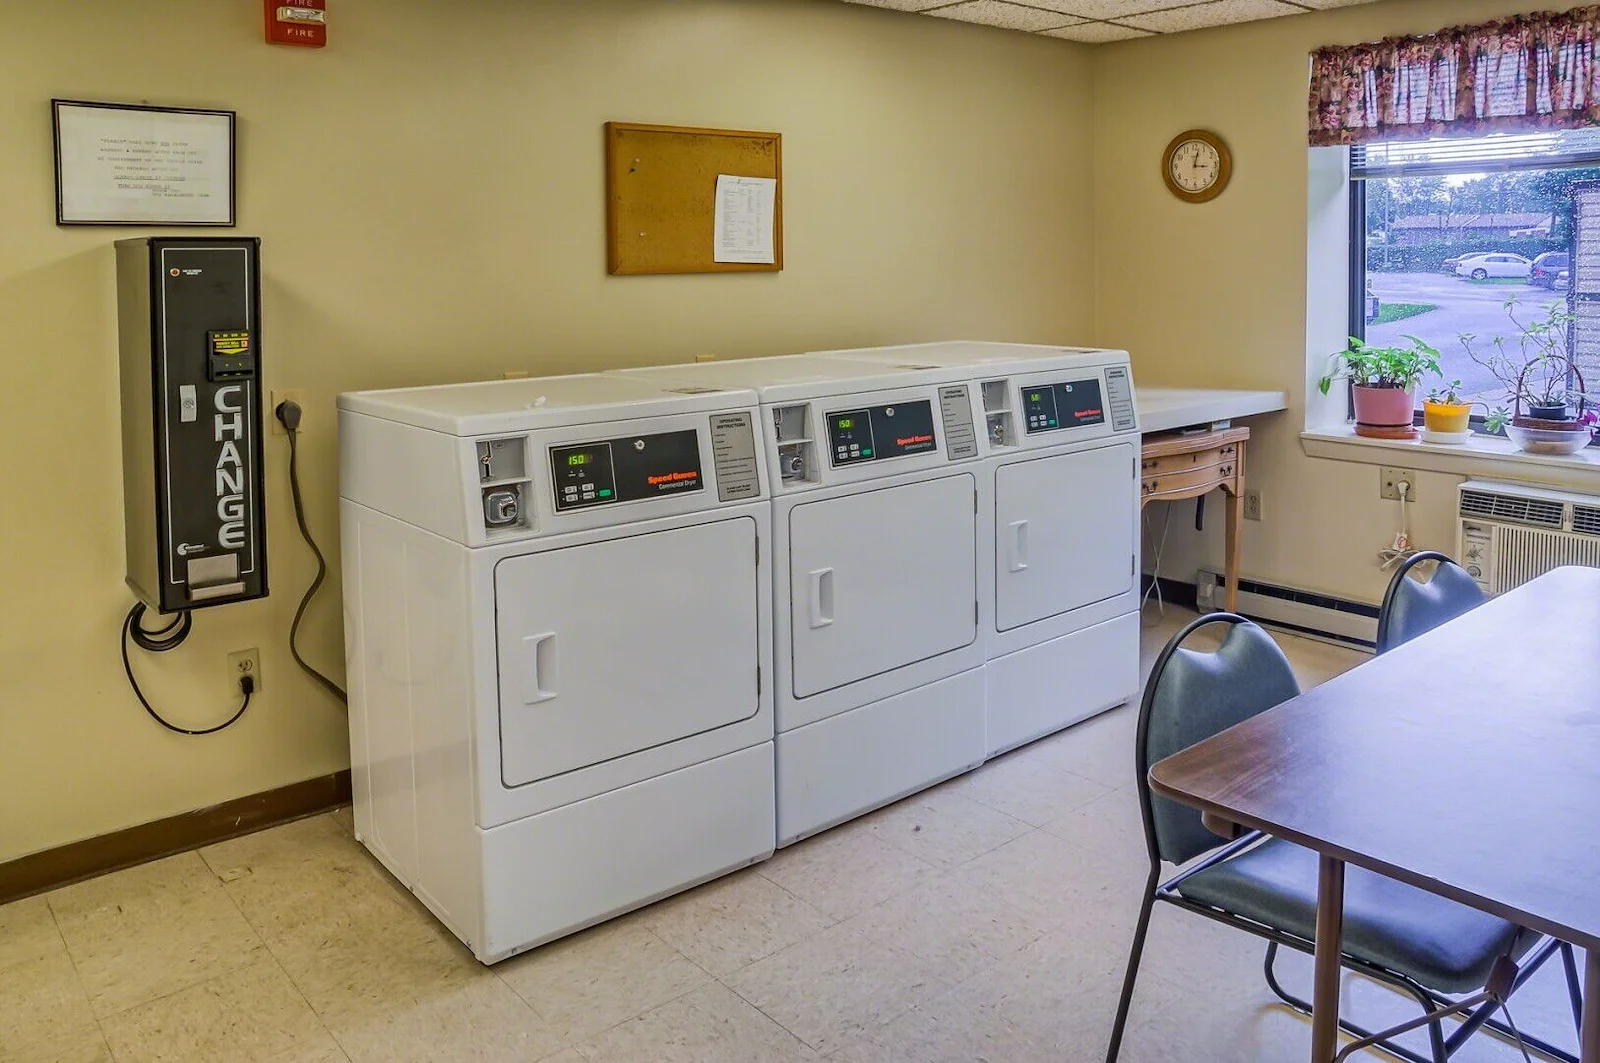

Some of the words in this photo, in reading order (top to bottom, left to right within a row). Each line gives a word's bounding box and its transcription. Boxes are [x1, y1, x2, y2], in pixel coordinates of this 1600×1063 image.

[287, 28, 314, 38] FIRE
[214, 385, 245, 549] CHANGE
[647, 474, 672, 484] Speed
[673, 471, 697, 480] Queen
